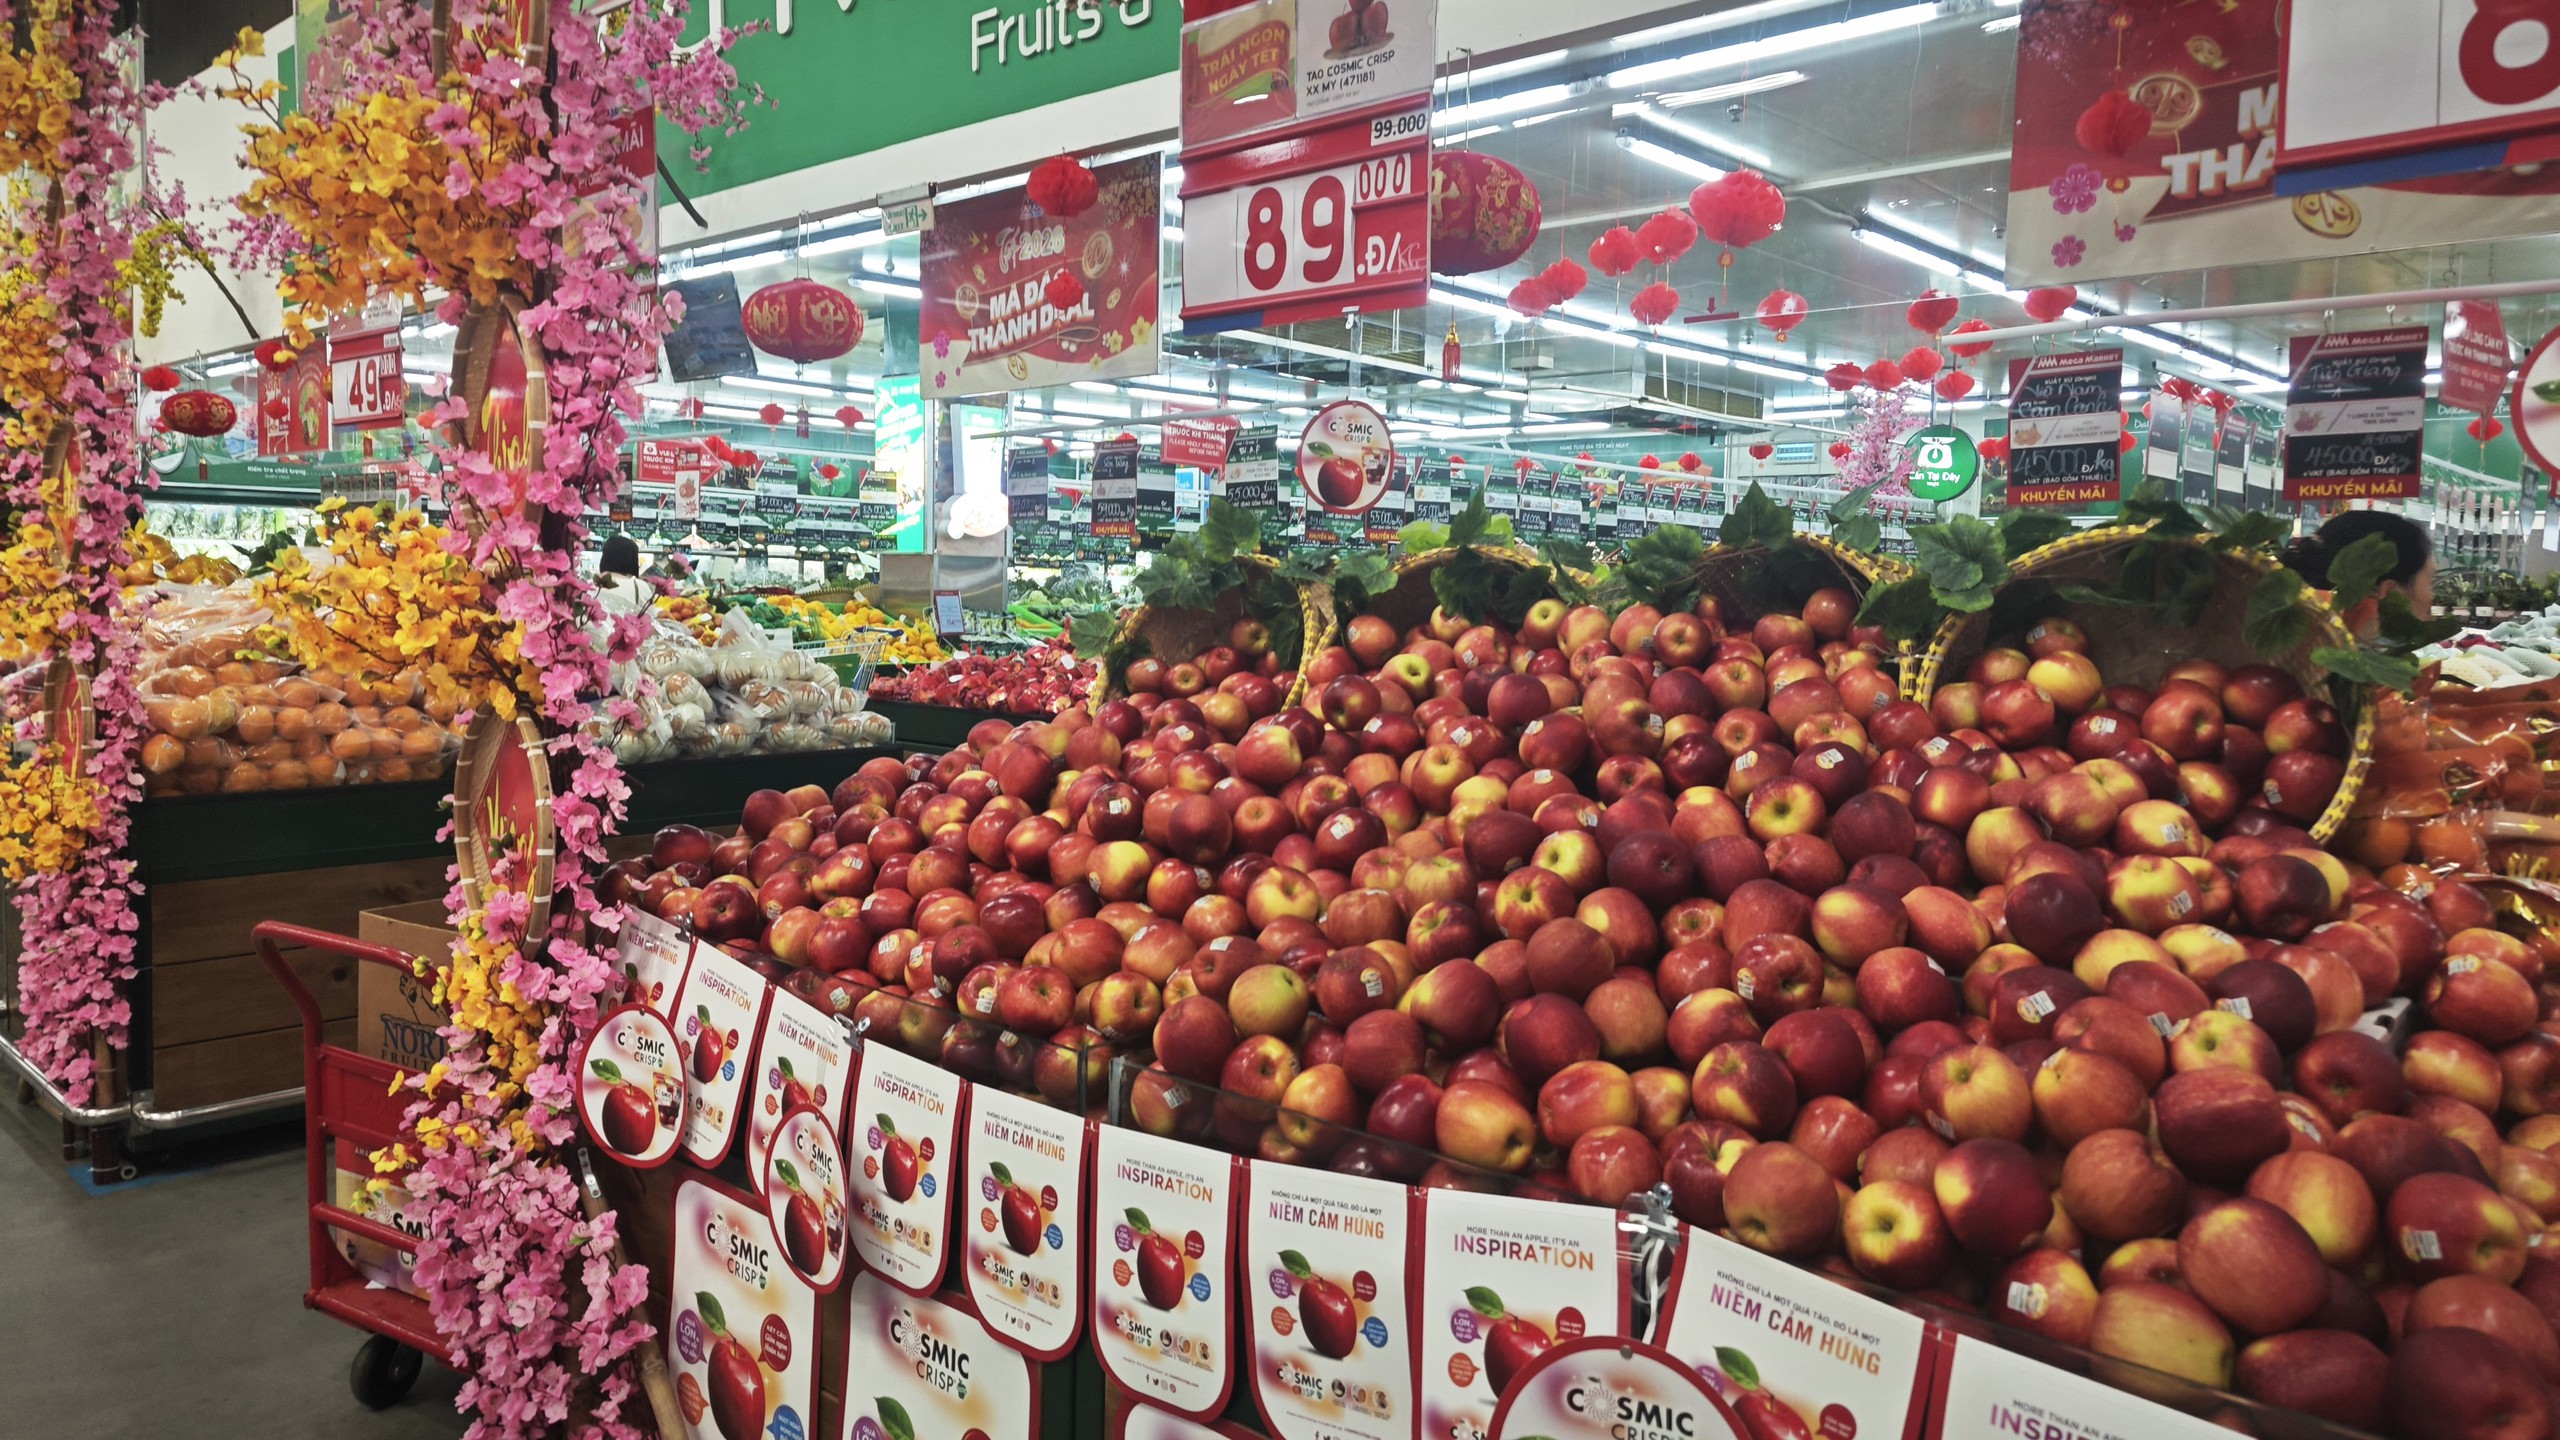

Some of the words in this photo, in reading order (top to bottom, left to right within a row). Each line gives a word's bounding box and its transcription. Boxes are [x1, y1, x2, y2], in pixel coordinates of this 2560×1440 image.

[971, 0, 1104, 73] Fruits
[1327, 59, 1364, 77] COSMIC
[1367, 50, 1395, 67] CRISP
[1306, 85, 1320, 96] XX
[1322, 81, 1337, 93] MY
[1373, 113, 1426, 139] 99.000
[1359, 155, 1406, 200] 000
[1018, 224, 1065, 261] 2026
[1244, 175, 1346, 291] 89
[349, 358, 379, 413] 49
[1329, 421, 1373, 436] COSMIC
[1344, 433, 1365, 444] CRISP
[2020, 484, 2076, 503] KHUYẾN
[2079, 485, 2106, 500] MÃI
[2299, 478, 2366, 497] KHUYẾN
[2371, 479, 2403, 495] MÃI
[699, 971, 752, 1012] INSPIRATION
[617, 1032, 665, 1057] COSMIC
[777, 1020, 798, 1041] NIỀM
[799, 1031, 815, 1052] CẢM
[634, 1051, 657, 1067] CRISP
[874, 1074, 945, 1117] INSPIRATION
[984, 1120, 1009, 1142] NIỀM
[1012, 1129, 1034, 1151] CẢM
[797, 1134, 833, 1173] COSMIC
[809, 1160, 827, 1181] CRISP
[1117, 1163, 1213, 1203] INSPIRATION
[1126, 1158, 1140, 1167] MORE
[1142, 1161, 1157, 1171] THAN
[1157, 1165, 1166, 1174] AN
[1185, 1173, 1195, 1181] IT'S
[1195, 1175, 1204, 1183] AN
[1269, 1199, 1304, 1224] NIỀM
[1309, 1206, 1339, 1231] CẢM
[1344, 1215, 1385, 1240] HỨNG
[707, 1222, 769, 1273] COSMIC
[1454, 1234, 1594, 1271] INSPIRATION
[1466, 1225, 1488, 1235] MORE
[1489, 1228, 1510, 1238] THAN
[1512, 1231, 1523, 1240] AN
[1524, 1234, 1551, 1245] APPLE,
[1551, 1237, 1566, 1246] IT'S
[1567, 1239, 1580, 1248] AN
[727, 1257, 756, 1285] CRISP
[981, 1258, 1015, 1280] COSMIC
[1717, 1269, 1745, 1287] KHÔNG
[1761, 1288, 1772, 1299] LÀ
[1773, 1293, 1791, 1307] MỘT
[1792, 1301, 1811, 1315] QUẢ
[1847, 1325, 1859, 1337] LÀ
[1861, 1330, 1881, 1346] MỘT
[1114, 1315, 1152, 1339] COSMIC
[1710, 1283, 1762, 1323] NIỀM
[1768, 1309, 1814, 1346] CẢM
[1819, 1331, 1882, 1376] HỨNG
[890, 1318, 970, 1380] COSMIC
[916, 1360, 954, 1393] CRISP
[1277, 1368, 1323, 1391] COSMIC
[1566, 1388, 1694, 1437] COSMIC
